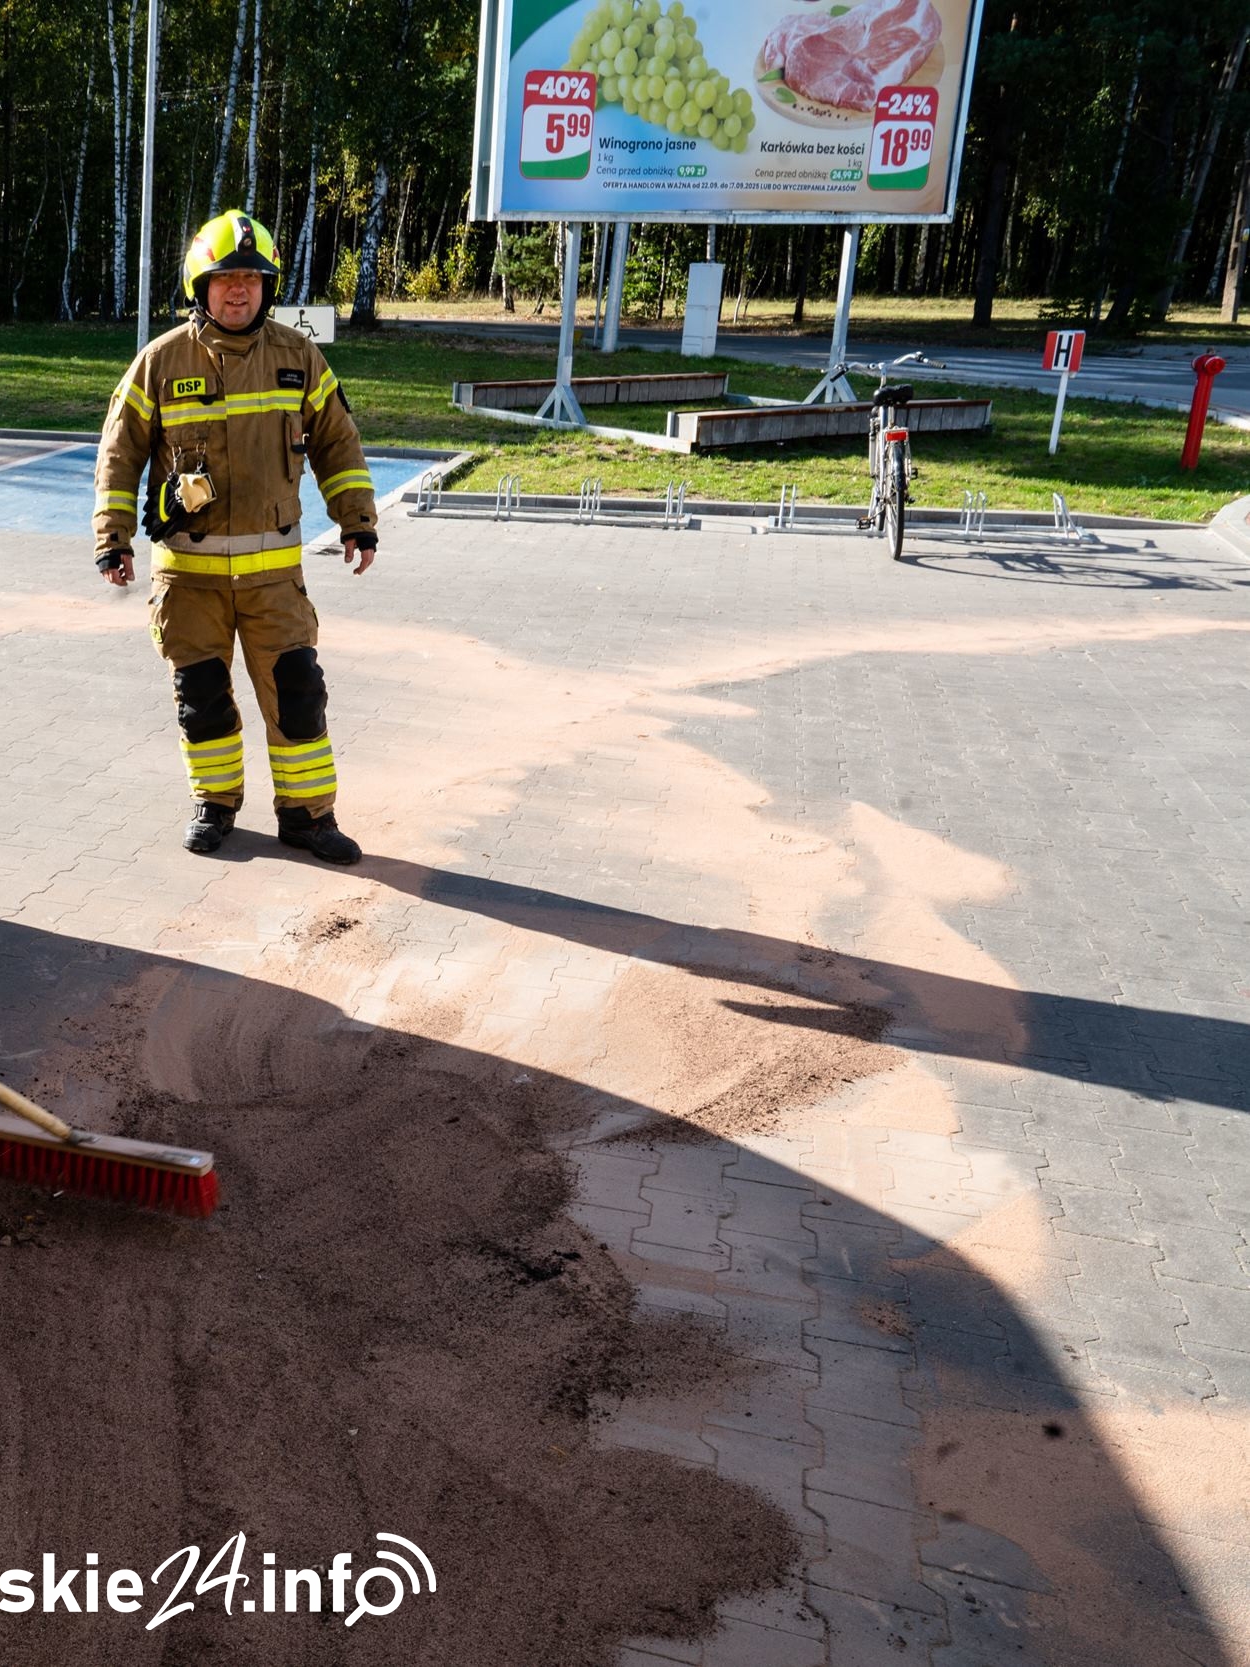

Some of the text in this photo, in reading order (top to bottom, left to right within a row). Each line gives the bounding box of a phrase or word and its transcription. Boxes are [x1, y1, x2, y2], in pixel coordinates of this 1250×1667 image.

[527, 76, 591, 99] -40%
[878, 93, 932, 116] -24%
[599, 136, 697, 154] Winogrono jasne
[760, 140, 865, 155] Karkówka bez kości
[603, 153, 614, 164] kg
[853, 159, 863, 169] kg
[596, 166, 705, 177] Cena przed obniżką: 9,99 zł
[755, 168, 861, 181] Cena przed obniżką: 24,99 zł
[602, 181, 628, 189] OFERTA
[667, 181, 691, 189] WAŻNA
[782, 183, 826, 191] WYCZERPANIA
[826, 183, 857, 192] ZAPASÓW
[1053, 334, 1074, 367] H
[177, 380, 202, 394] OSP
